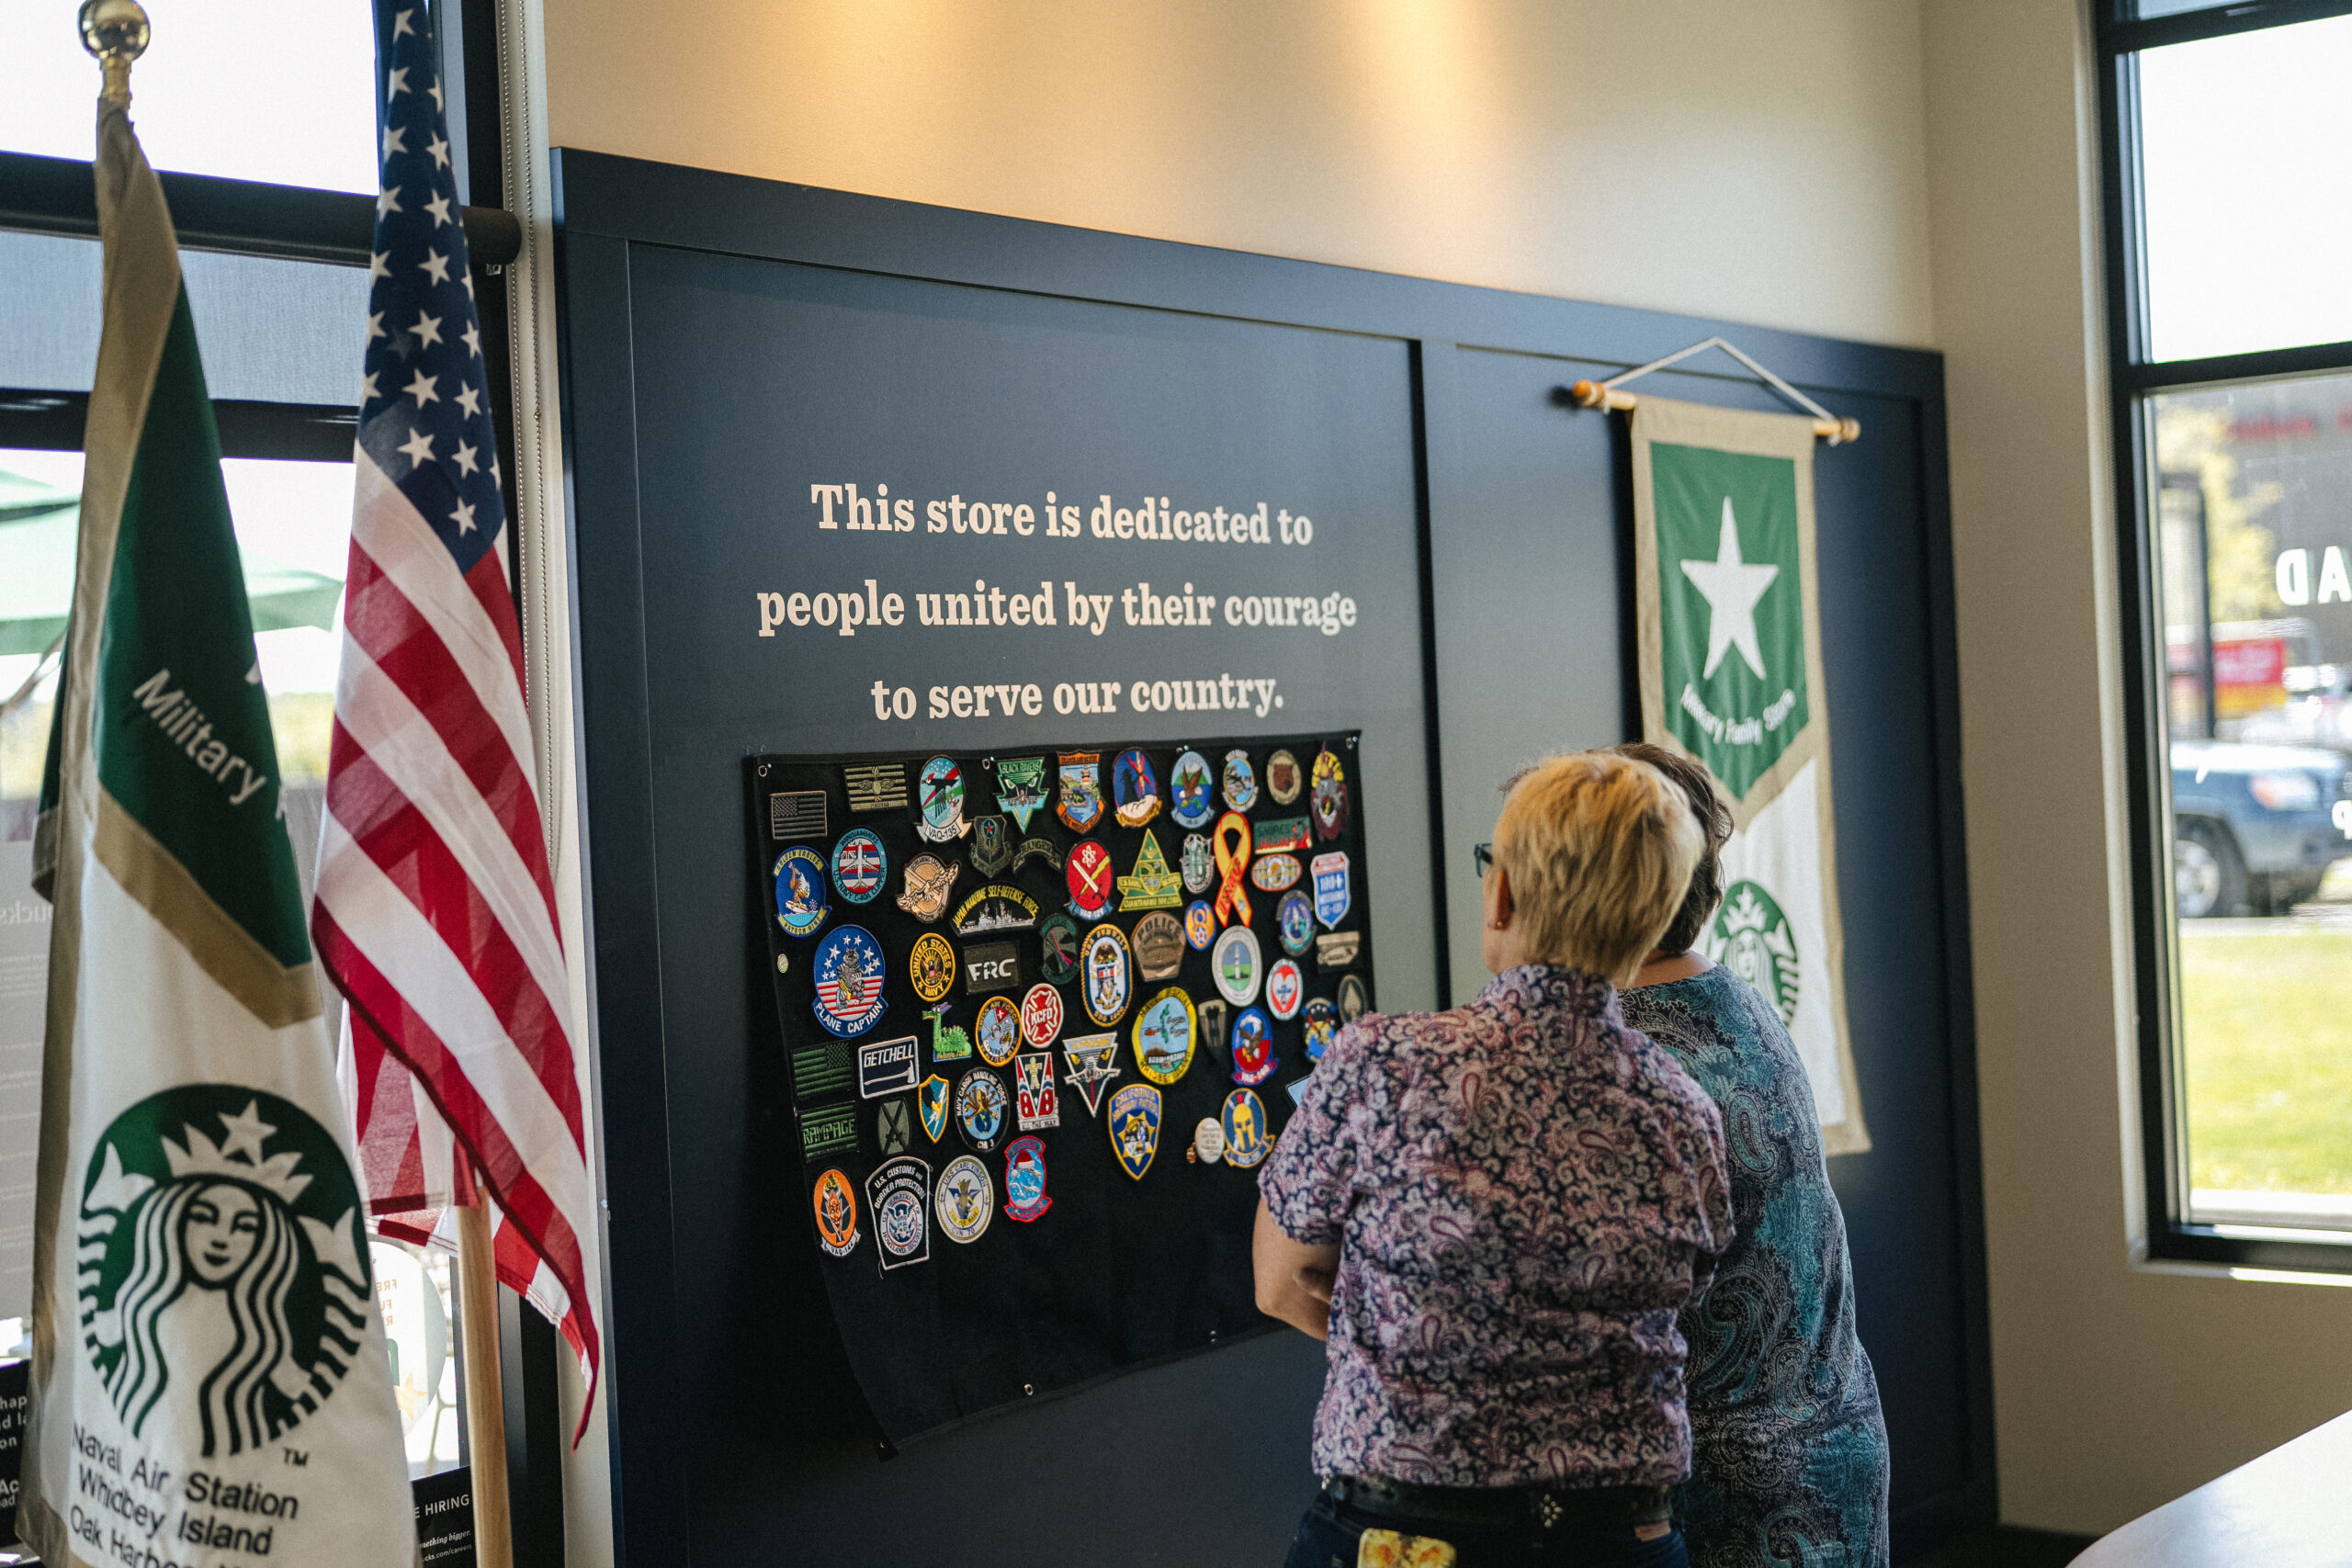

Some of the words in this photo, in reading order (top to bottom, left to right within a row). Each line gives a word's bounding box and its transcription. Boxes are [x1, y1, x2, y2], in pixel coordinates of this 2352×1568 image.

[811, 483, 915, 533] This
[926, 494, 1035, 536] store
[1045, 491, 1080, 537] is
[1091, 495, 1270, 544] dedicated
[1277, 509, 1313, 546] to
[757, 580, 904, 637] people
[916, 580, 1056, 626] united
[1064, 581, 1113, 636] by
[1122, 583, 1216, 626] their
[1224, 591, 1357, 636] courage
[871, 680, 916, 720] to
[929, 678, 1042, 719] serve
[1053, 680, 1121, 716] our
[1130, 673, 1283, 718] country.
[132, 669, 267, 805] Military
[1002, 763, 1018, 773] BLACK
[1020, 762, 1041, 772] RAVENS
[928, 826, 956, 840] VAQ-135
[777, 851, 796, 871] GOLDEN
[798, 850, 820, 865] EAGLES
[839, 886, 854, 900] NAVY
[872, 867, 886, 897] CLIPPER
[952, 905, 967, 928] JAPAN
[988, 885, 1024, 903] SELF-DEFENSE
[1023, 896, 1039, 915] FORCE
[1137, 918, 1182, 940] POLICE
[912, 942, 927, 977] UNITED
[931, 939, 951, 968] STATES
[1085, 939, 1094, 956] USS
[967, 958, 1015, 981] FRC
[924, 986, 944, 996] NAVY
[816, 1003, 841, 1032] PLANE
[847, 1001, 883, 1033] CAPTAIN
[1002, 1003, 1018, 1023] FORCE
[1030, 1009, 1052, 1024] KCFD
[864, 1043, 915, 1067] GETCHELL
[958, 1076, 972, 1100] CARGO
[973, 1071, 997, 1086] HANDLING
[996, 1084, 1007, 1106] FORCE
[1115, 1088, 1155, 1108] CALIFORNIA
[803, 1119, 854, 1145] RAMPAGE
[875, 1176, 887, 1189] U.S.
[888, 1166, 916, 1179] CUSTOMS
[943, 1170, 955, 1185] USS
[955, 1161, 970, 1170] CARL
[971, 1164, 988, 1187] VINSON
[875, 1179, 895, 1210] BORDER
[895, 1179, 925, 1200] PROTECTION
[967, 1227, 975, 1236] 70
[73, 1423, 121, 1473] Naval
[131, 1457, 169, 1492] Air
[186, 1472, 298, 1519] Station
[79, 1464, 165, 1540] Whidbey
[178, 1511, 273, 1555] Island
[425, 1494, 469, 1516] HIRING
[71, 1505, 103, 1550] Oak
[448, 1529, 470, 1542] bigger.
